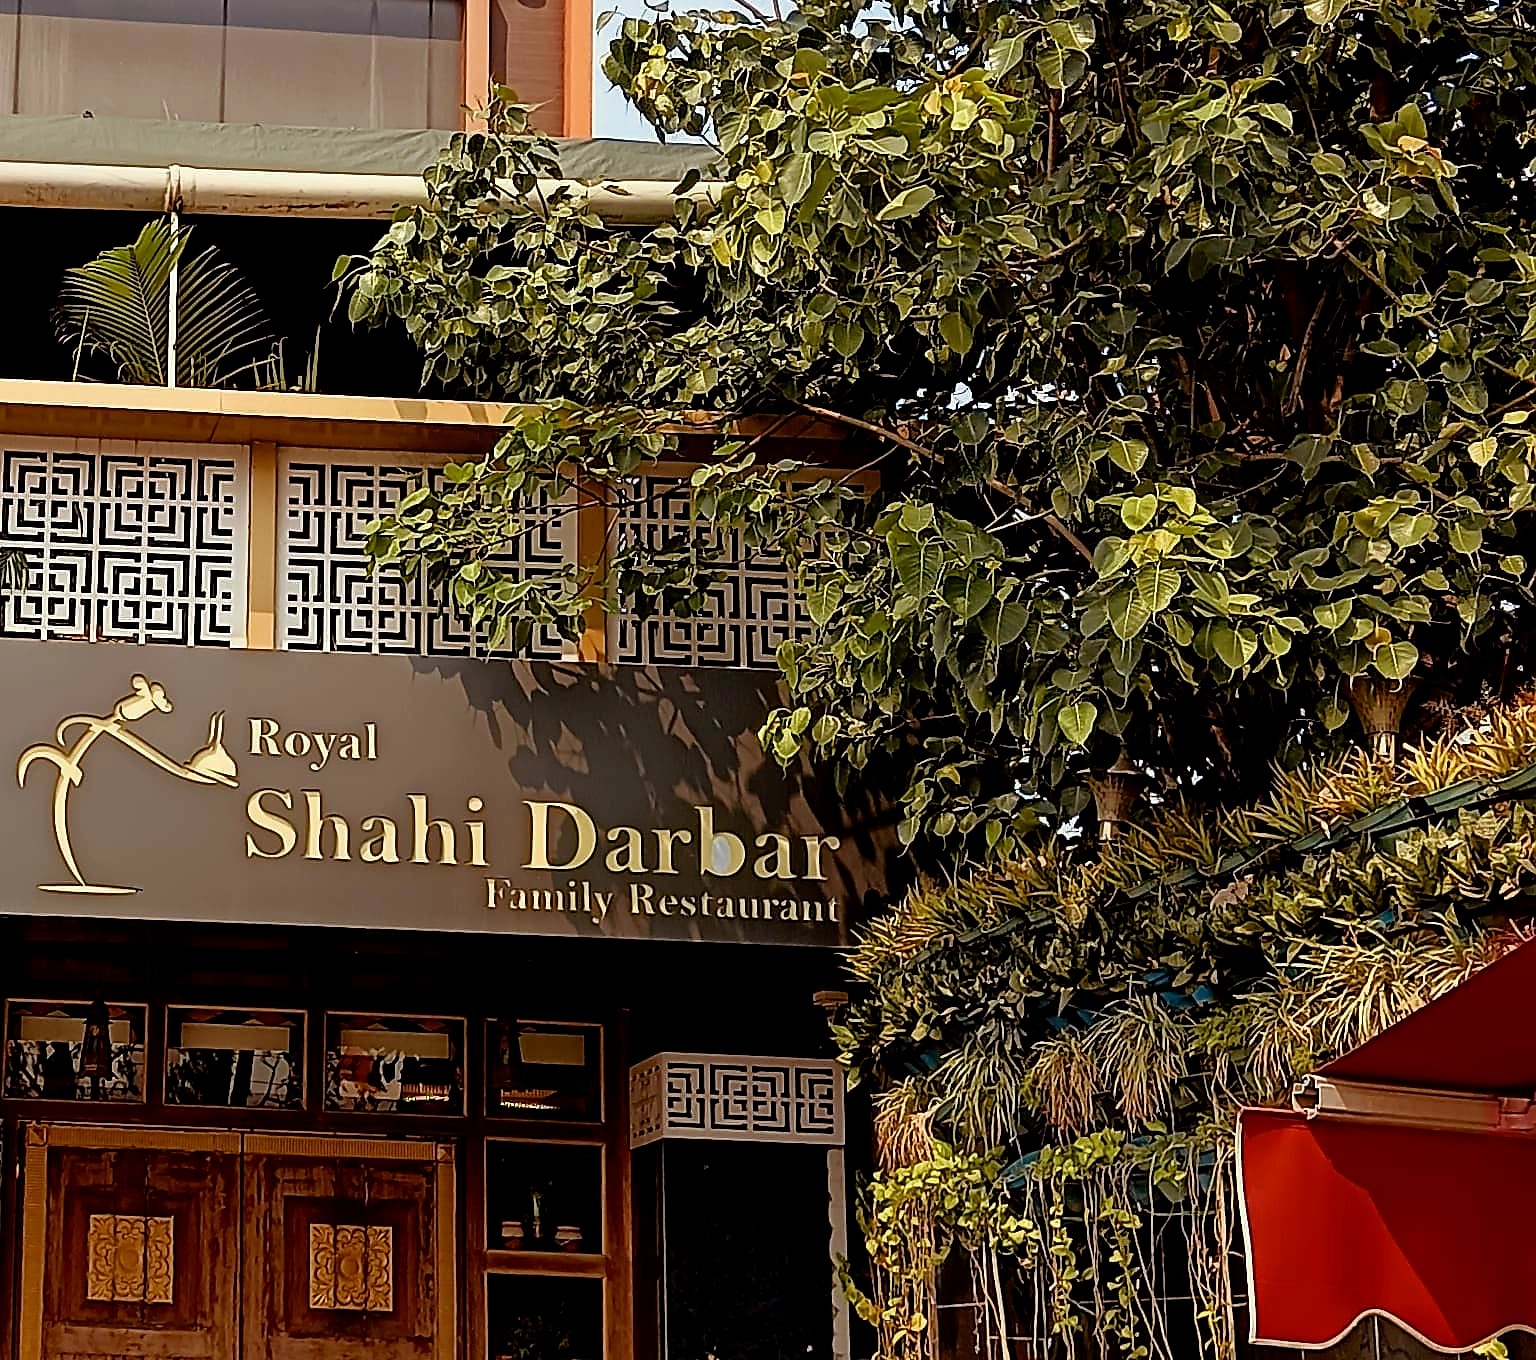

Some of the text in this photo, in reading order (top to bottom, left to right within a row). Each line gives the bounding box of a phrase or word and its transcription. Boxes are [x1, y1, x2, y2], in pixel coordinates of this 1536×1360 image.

[247, 717, 378, 772] Royal
[245, 789, 841, 882] Shahi Darbar
[485, 877, 841, 924] Family Restaurant
